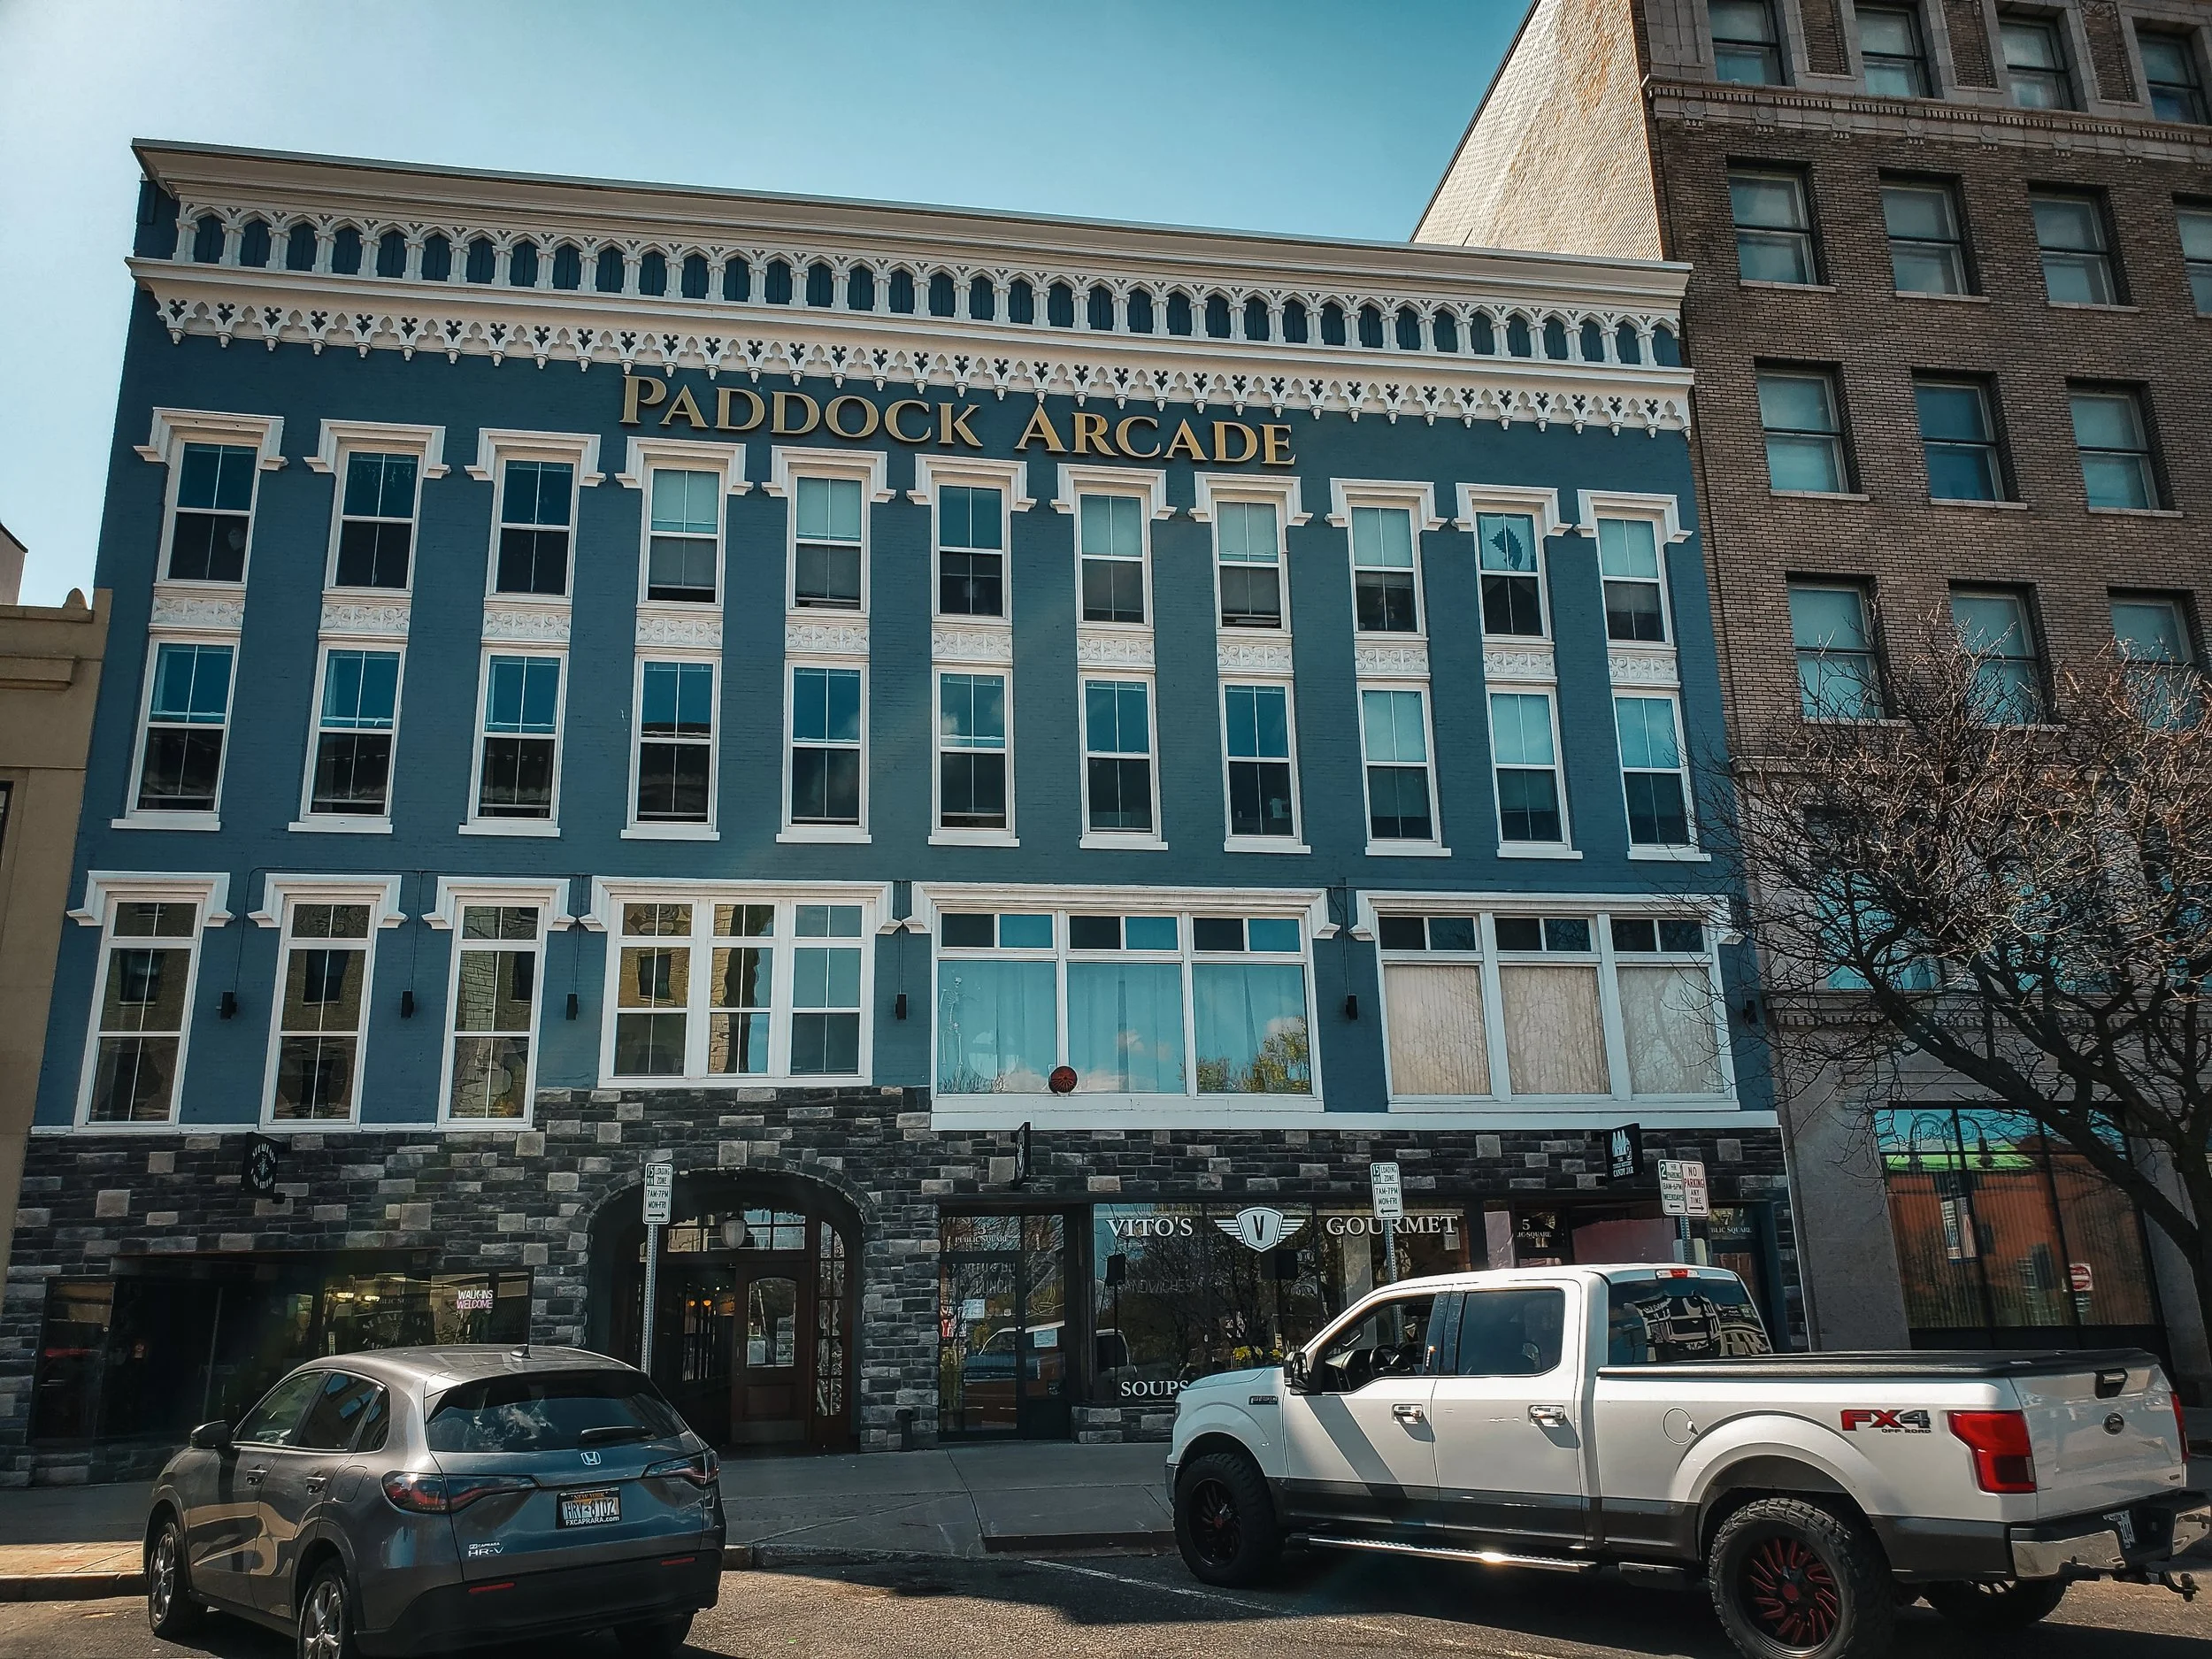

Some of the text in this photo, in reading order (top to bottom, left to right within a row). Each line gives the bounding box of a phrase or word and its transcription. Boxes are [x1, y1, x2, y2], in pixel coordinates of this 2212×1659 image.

[619, 375, 1296, 465] PADDOCK ARCADE
[648, 1166, 654, 1177] 15
[1373, 1165, 1380, 1175] 15
[1661, 1164, 1666, 1177] 2
[1688, 1167, 1697, 1177] NO
[1685, 1179, 1704, 1187] PARKING
[1522, 1218, 1531, 1230] 5
[1722, 1214, 1731, 1225] 7
[978, 1223, 987, 1234] 3
[1106, 1217, 1193, 1238] VITO'S
[1252, 1214, 1265, 1240] V
[1326, 1215, 1458, 1236] GOURMET
[457, 1289, 493, 1300] WALK-INS
[457, 1299, 493, 1310] WELCOME
[1120, 1379, 1189, 1397] SOUPS
[1840, 1409, 1931, 1431] FX4
[566, 1498, 615, 1519] HRV 8102
[565, 1516, 619, 1525] FXCAPRARA.com
[468, 1546, 504, 1557] HR-V
